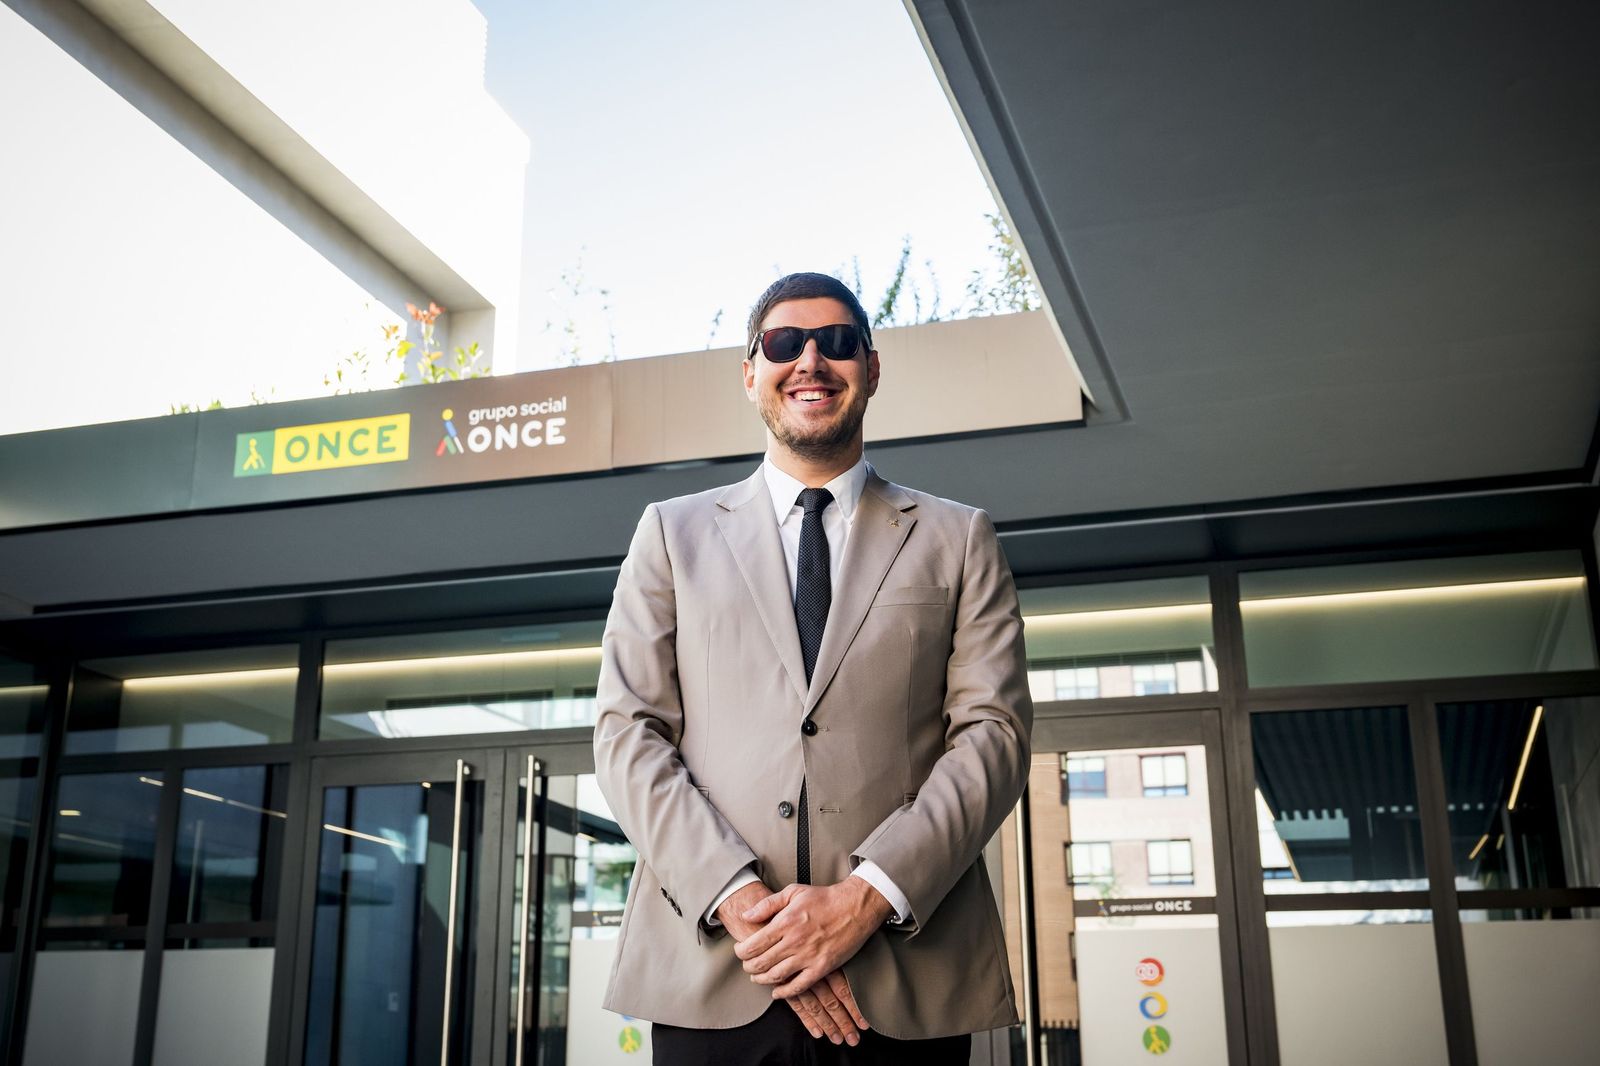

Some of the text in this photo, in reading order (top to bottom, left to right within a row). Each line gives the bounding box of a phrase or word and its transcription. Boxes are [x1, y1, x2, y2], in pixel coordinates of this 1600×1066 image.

[469, 396, 567, 425] grupo social
[285, 425, 398, 463] ONCE
[467, 418, 567, 453] ONCE
[1154, 900, 1192, 911] ONCE
